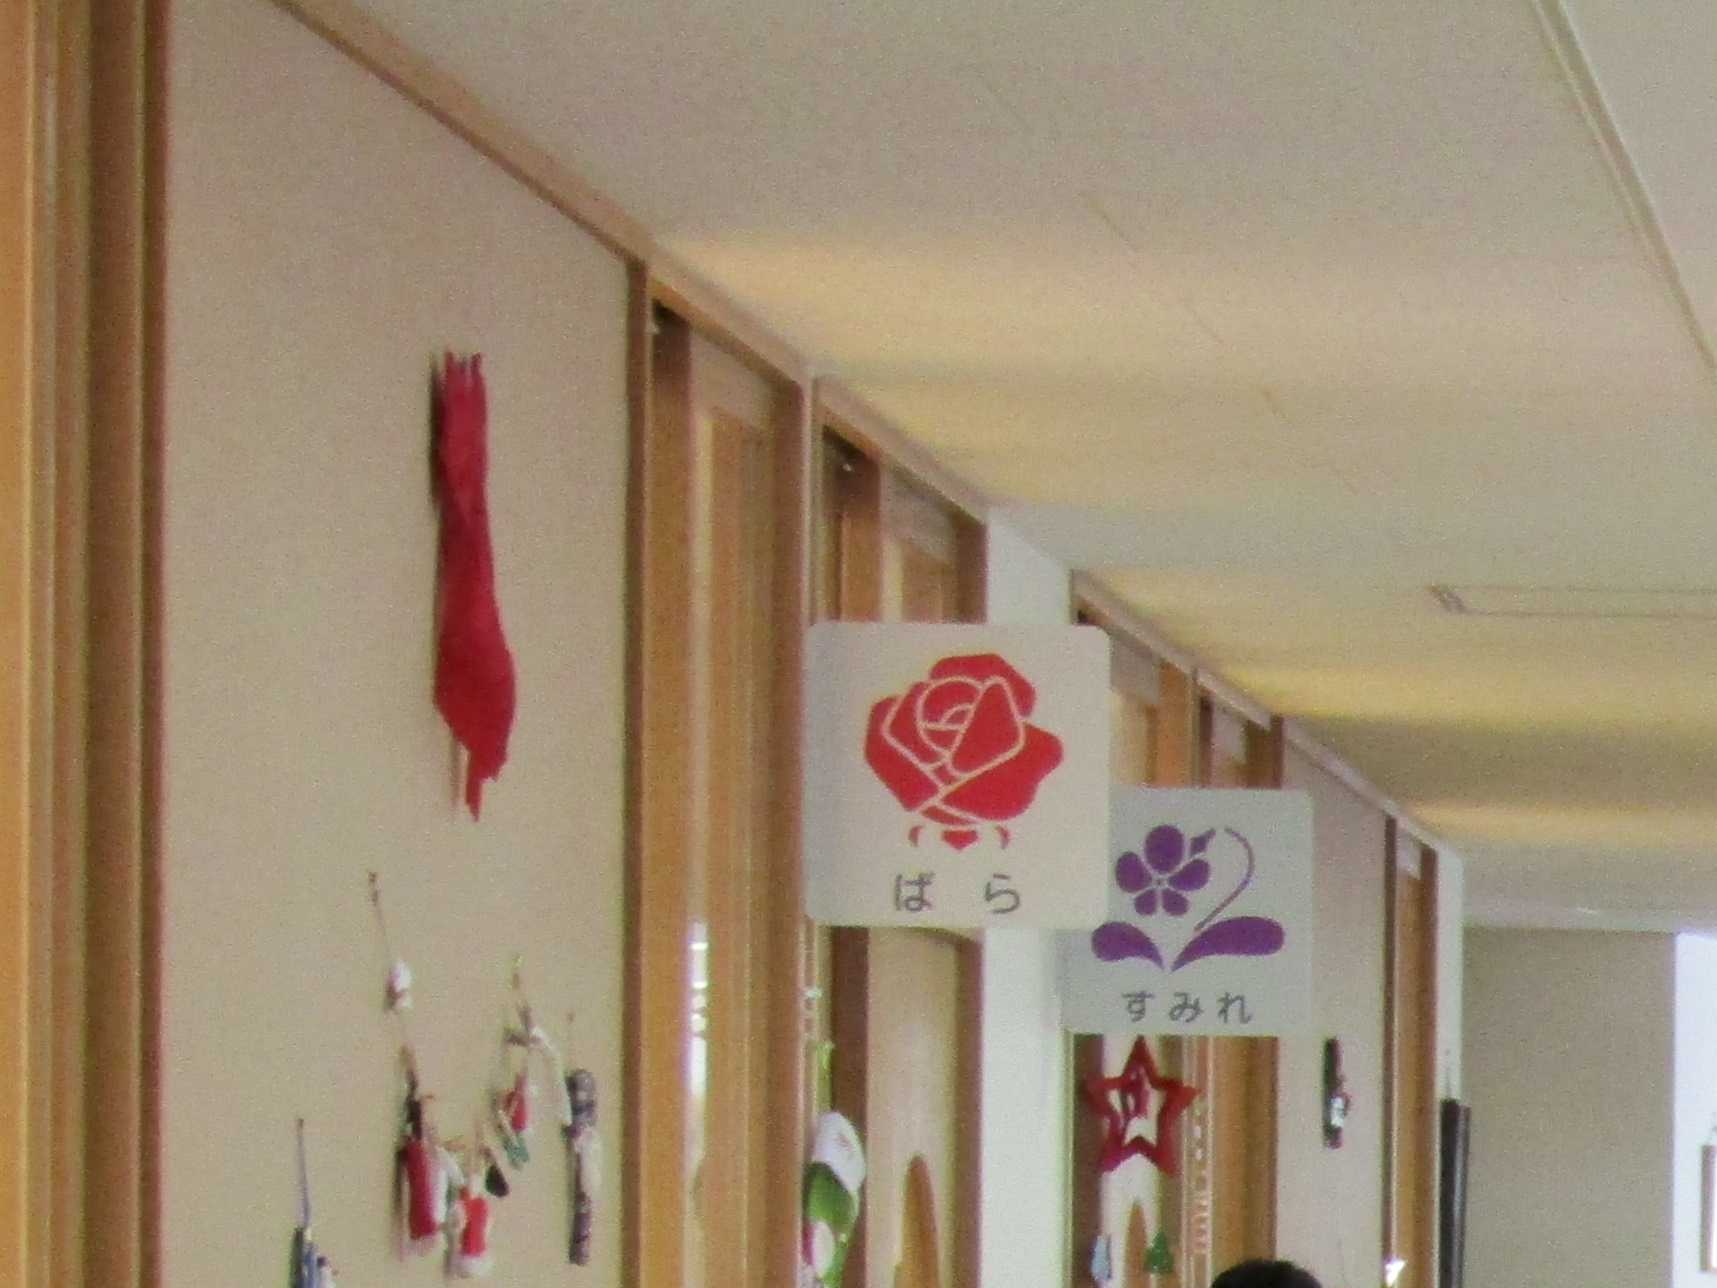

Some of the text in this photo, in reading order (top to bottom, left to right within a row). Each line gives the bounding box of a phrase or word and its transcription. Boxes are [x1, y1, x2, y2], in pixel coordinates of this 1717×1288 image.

[894, 871, 1021, 914] ばら
[1121, 990, 1254, 1024] すみれ
